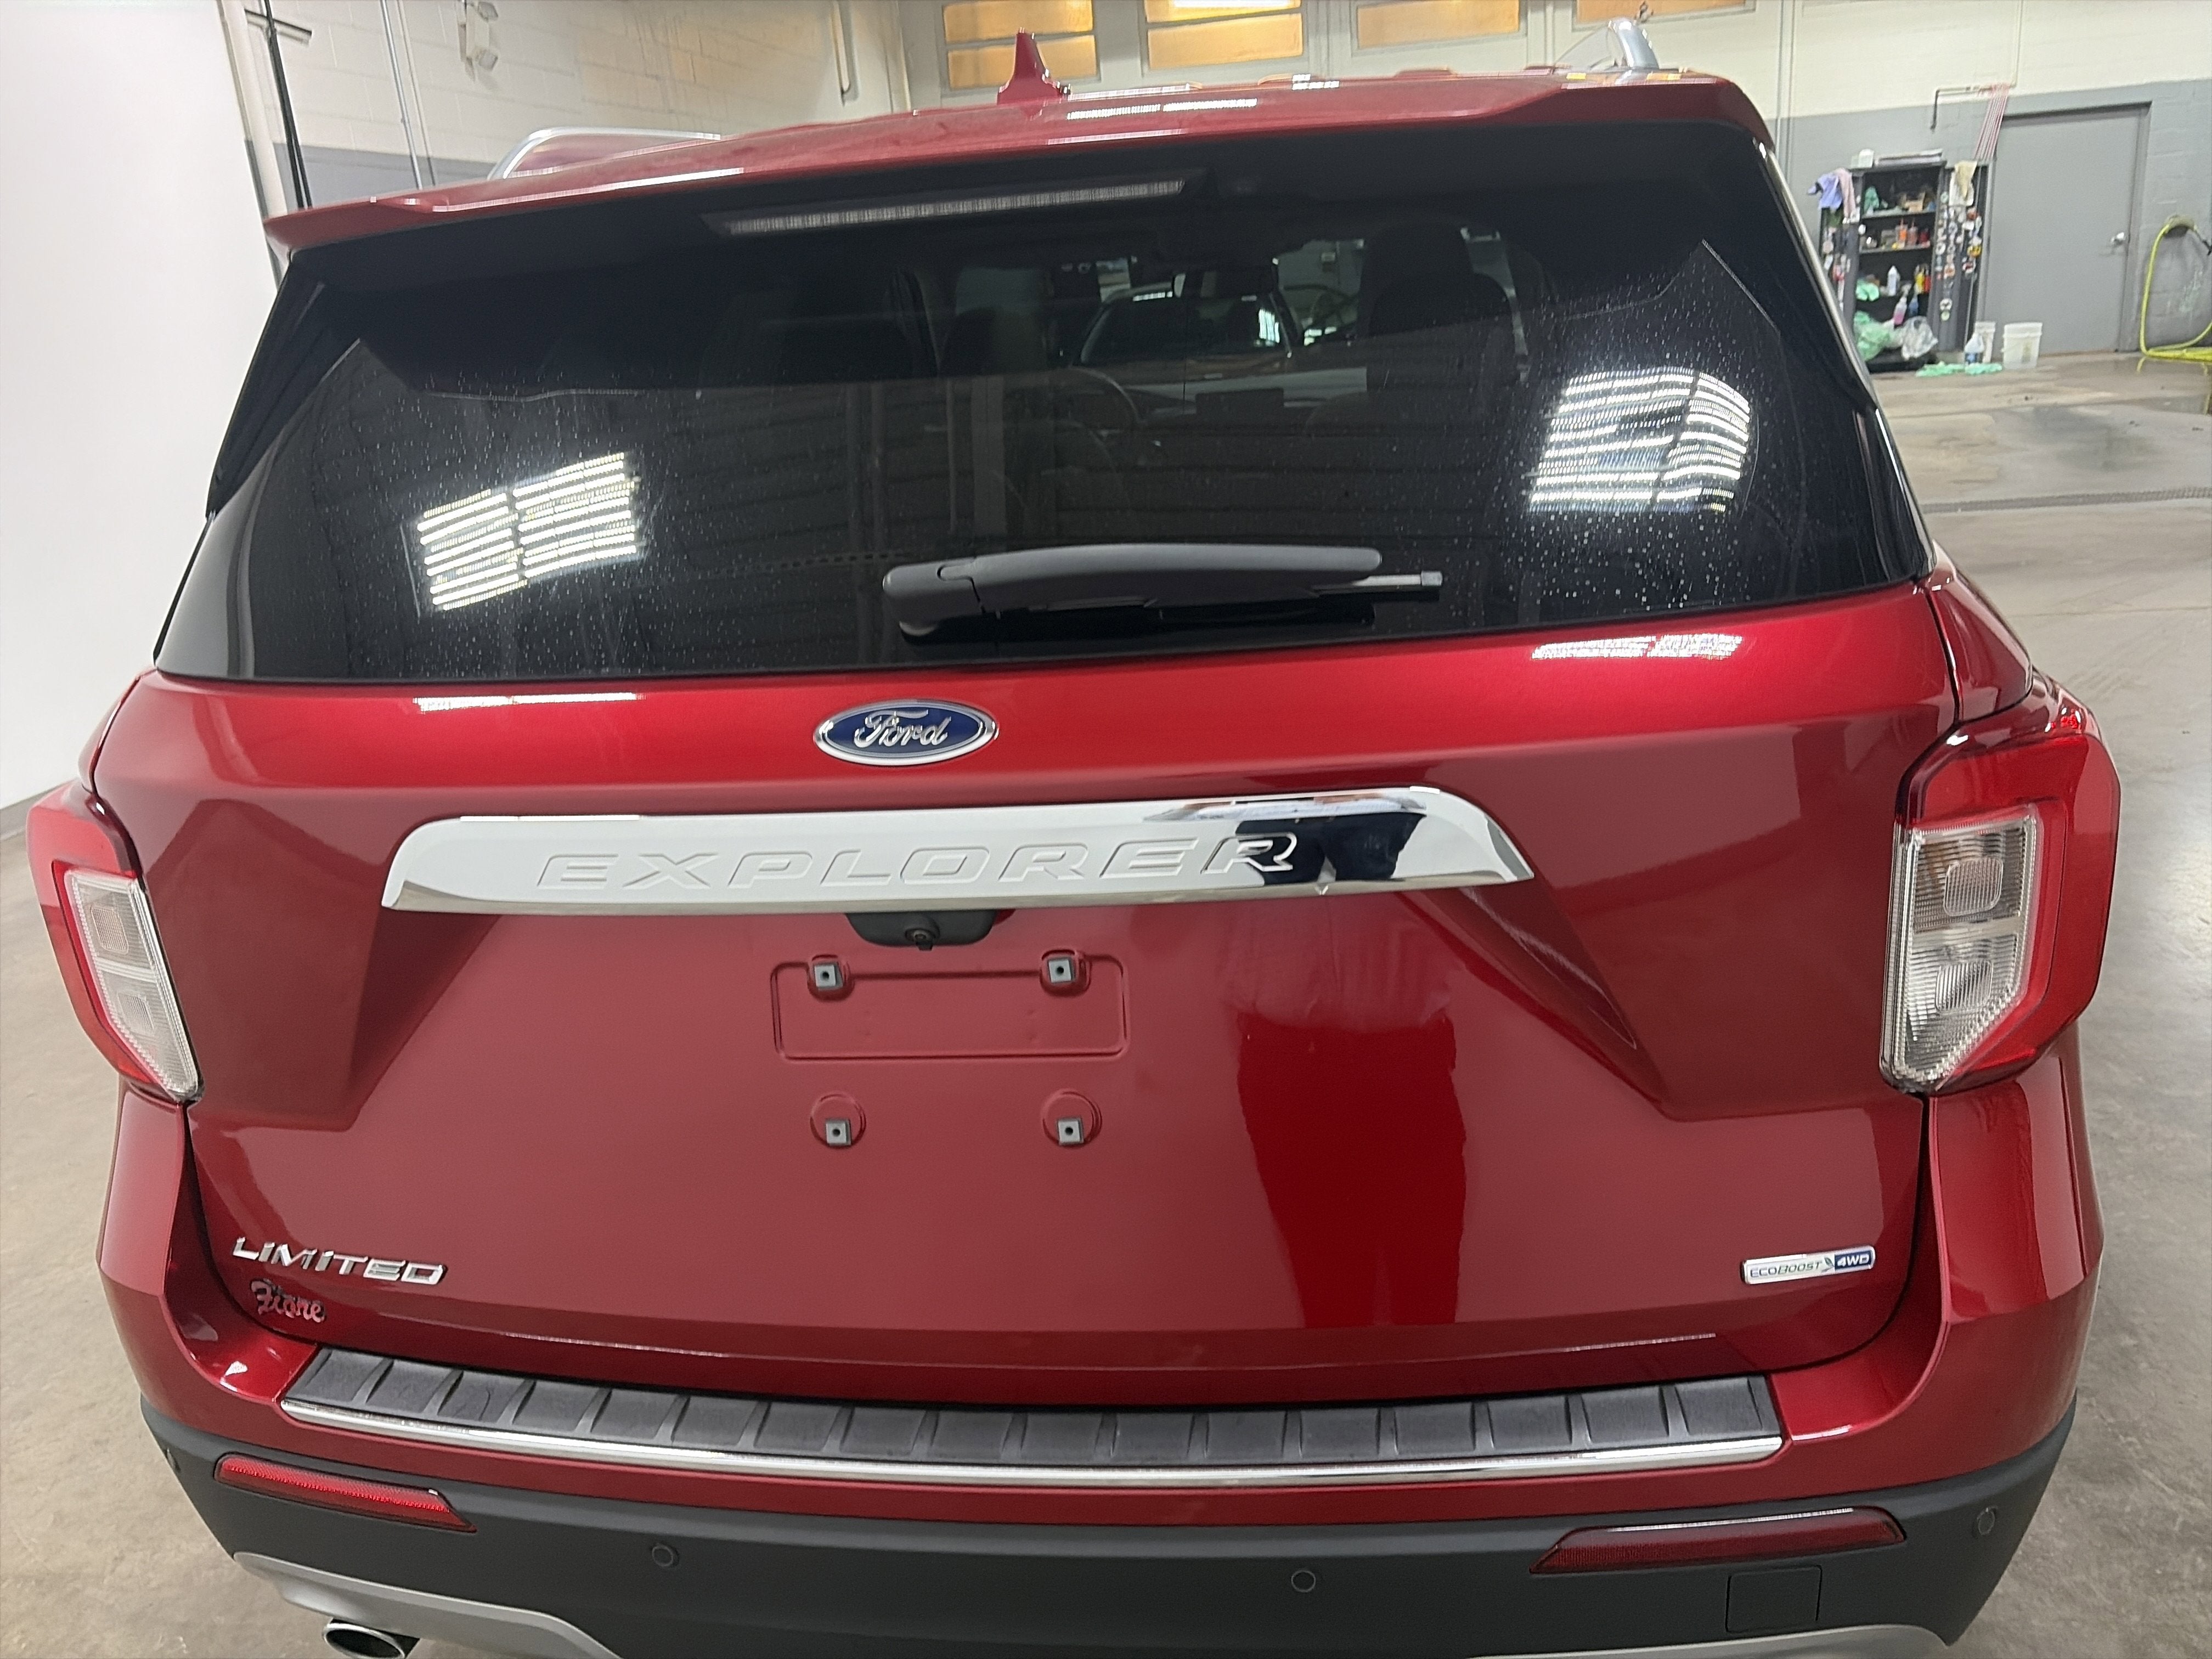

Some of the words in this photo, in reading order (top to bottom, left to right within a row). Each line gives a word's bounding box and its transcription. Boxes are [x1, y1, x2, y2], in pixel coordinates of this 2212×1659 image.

[854, 709, 951, 748] Ford
[536, 832, 1298, 890] EXPLORER
[233, 1237, 444, 1285] LIMITED
[1750, 1261, 1822, 1278] ECOBOOST
[1837, 1254, 1870, 1267] 4WD
